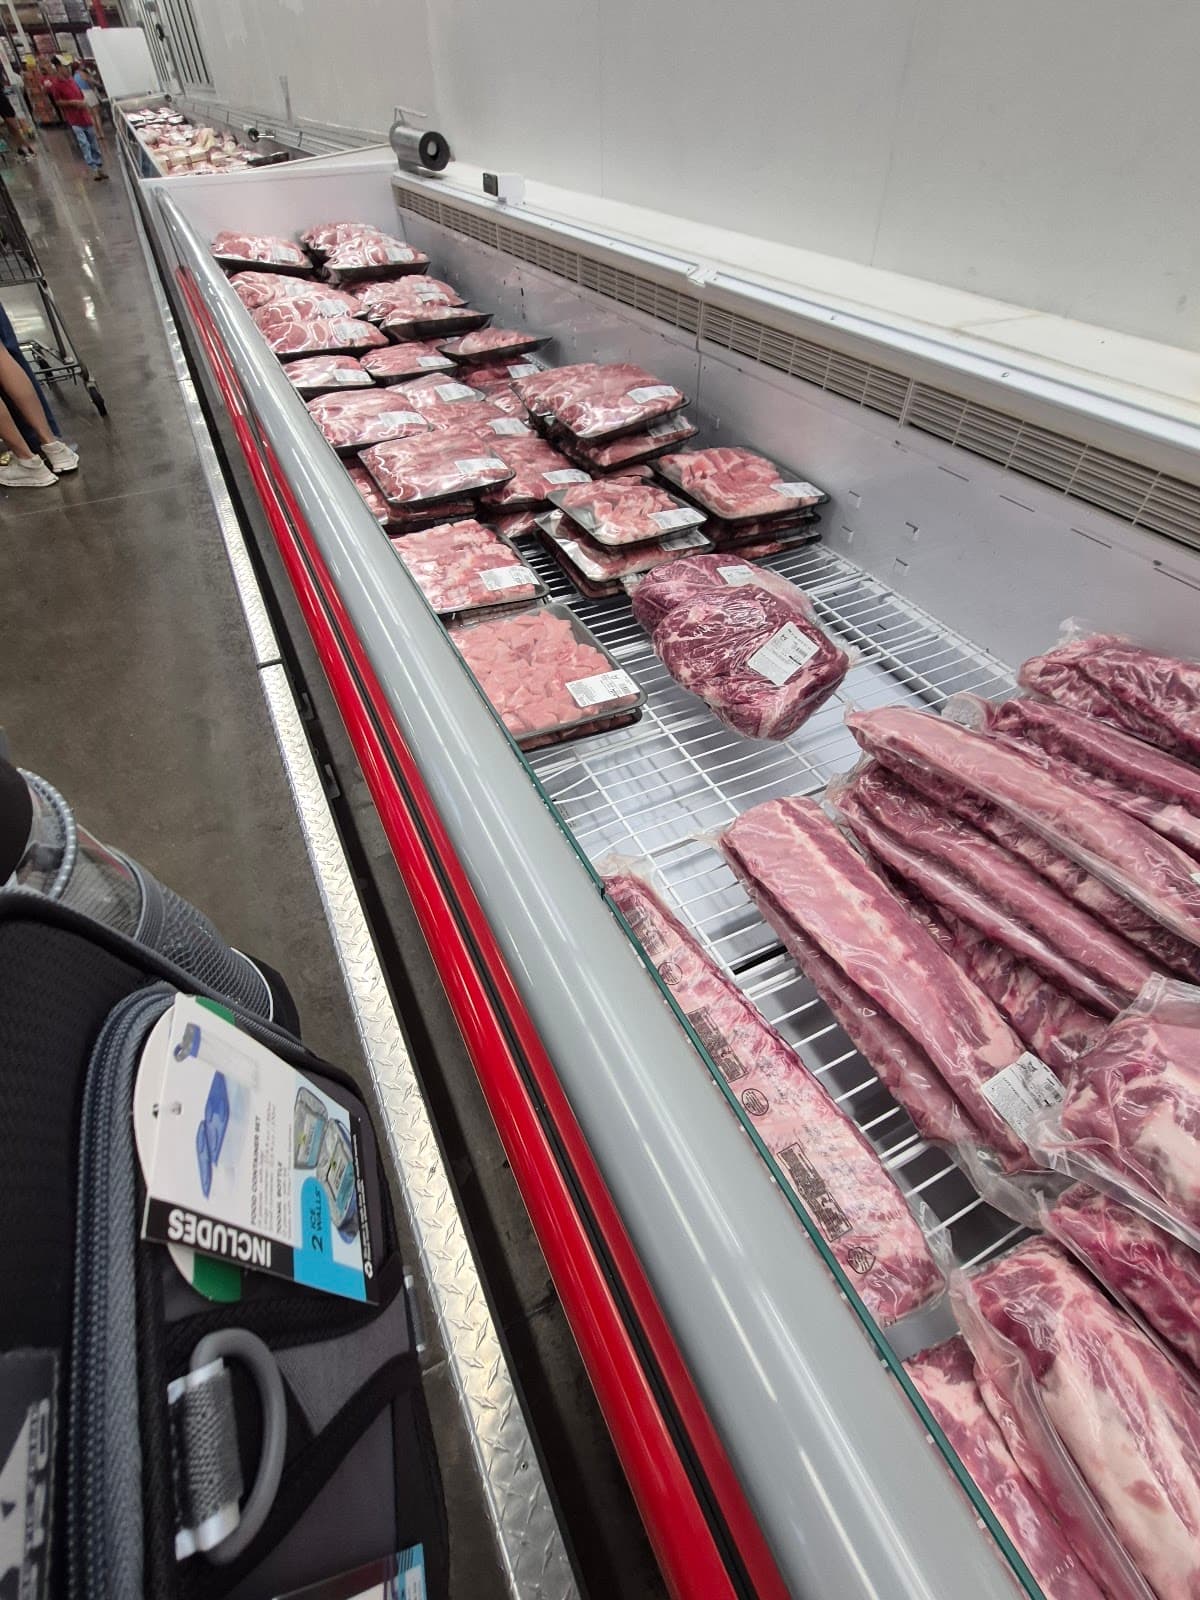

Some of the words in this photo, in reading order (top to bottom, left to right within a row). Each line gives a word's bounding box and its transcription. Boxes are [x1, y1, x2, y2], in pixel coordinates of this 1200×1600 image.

[252, 1133, 260, 1193] CONTAINER
[168, 1207, 271, 1267] INCLUDES
[312, 1235, 322, 1253] 2
